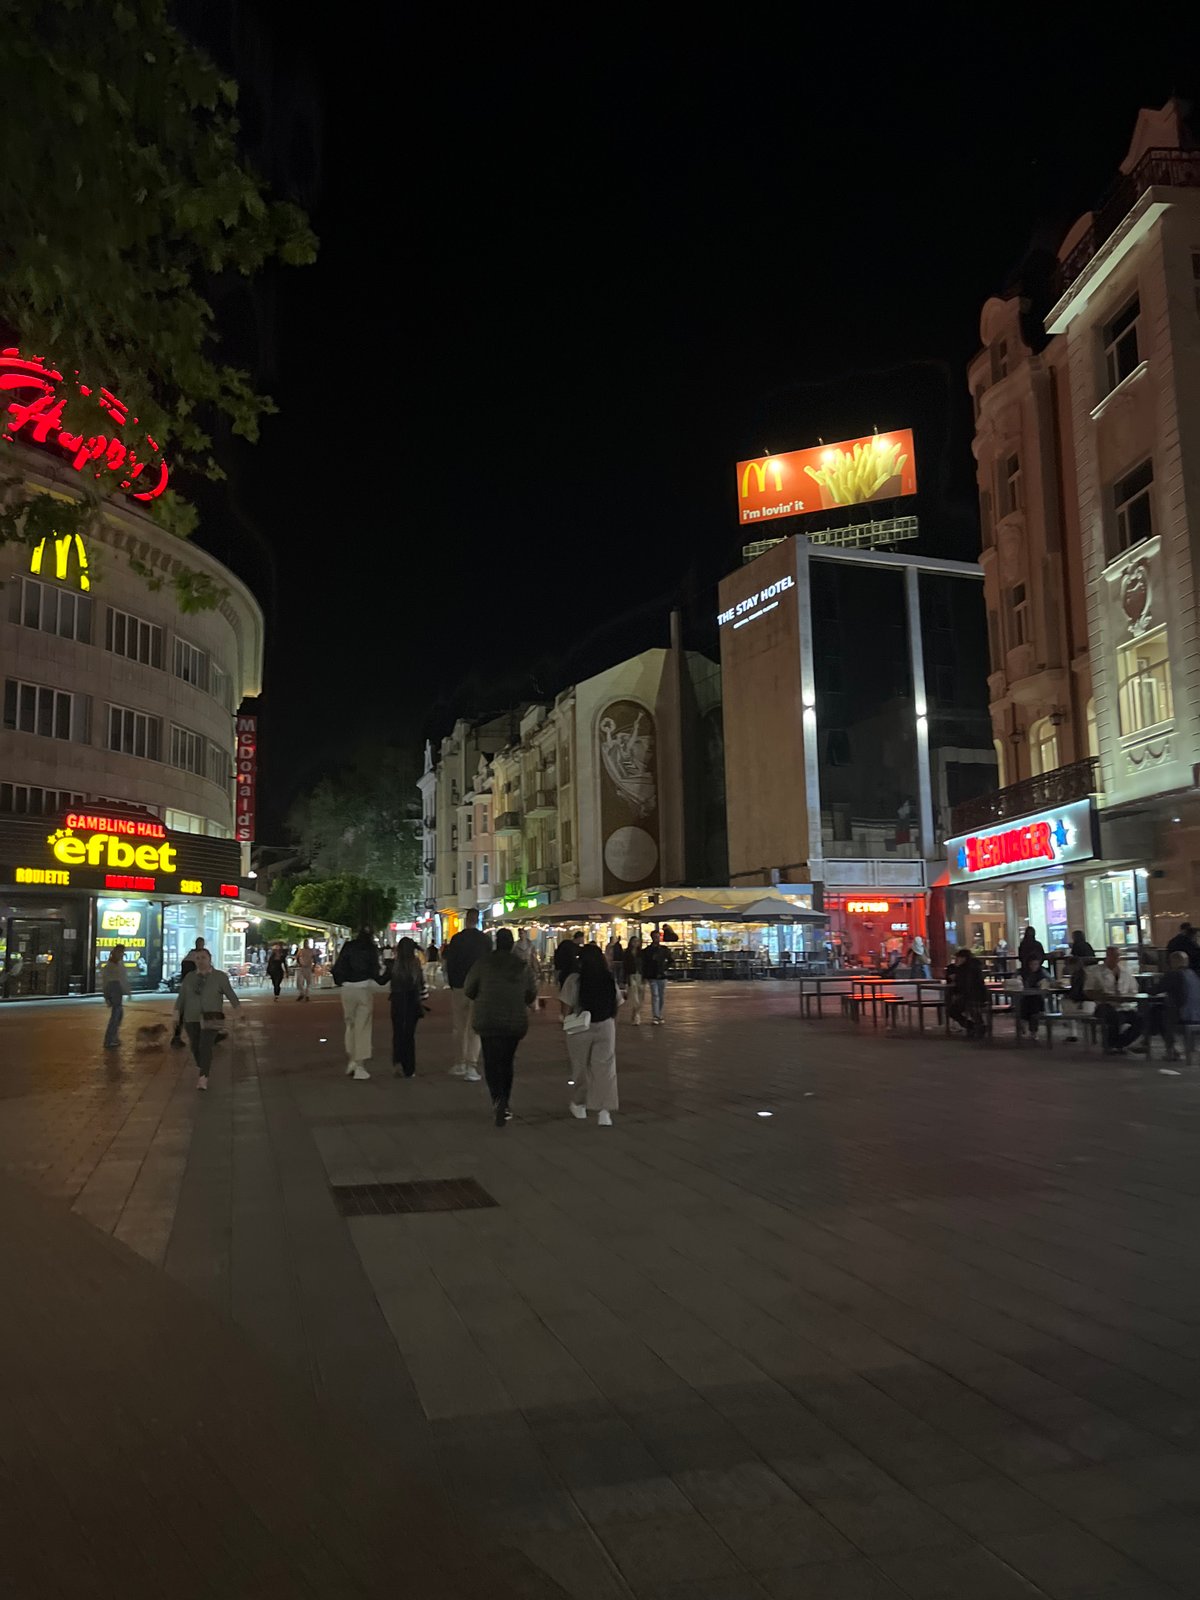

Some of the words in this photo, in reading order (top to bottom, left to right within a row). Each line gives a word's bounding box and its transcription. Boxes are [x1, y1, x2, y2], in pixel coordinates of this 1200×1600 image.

[742, 509, 761, 520] i'm
[762, 502, 793, 517] lovin'
[794, 500, 805, 511] it
[716, 607, 736, 626] THE
[735, 593, 760, 616] STAY
[760, 575, 796, 602] HOTEL
[66, 813, 136, 835] GAMBLING
[137, 821, 166, 838] HALL
[53, 833, 178, 873] efbet
[15, 867, 71, 886] ROULETTE
